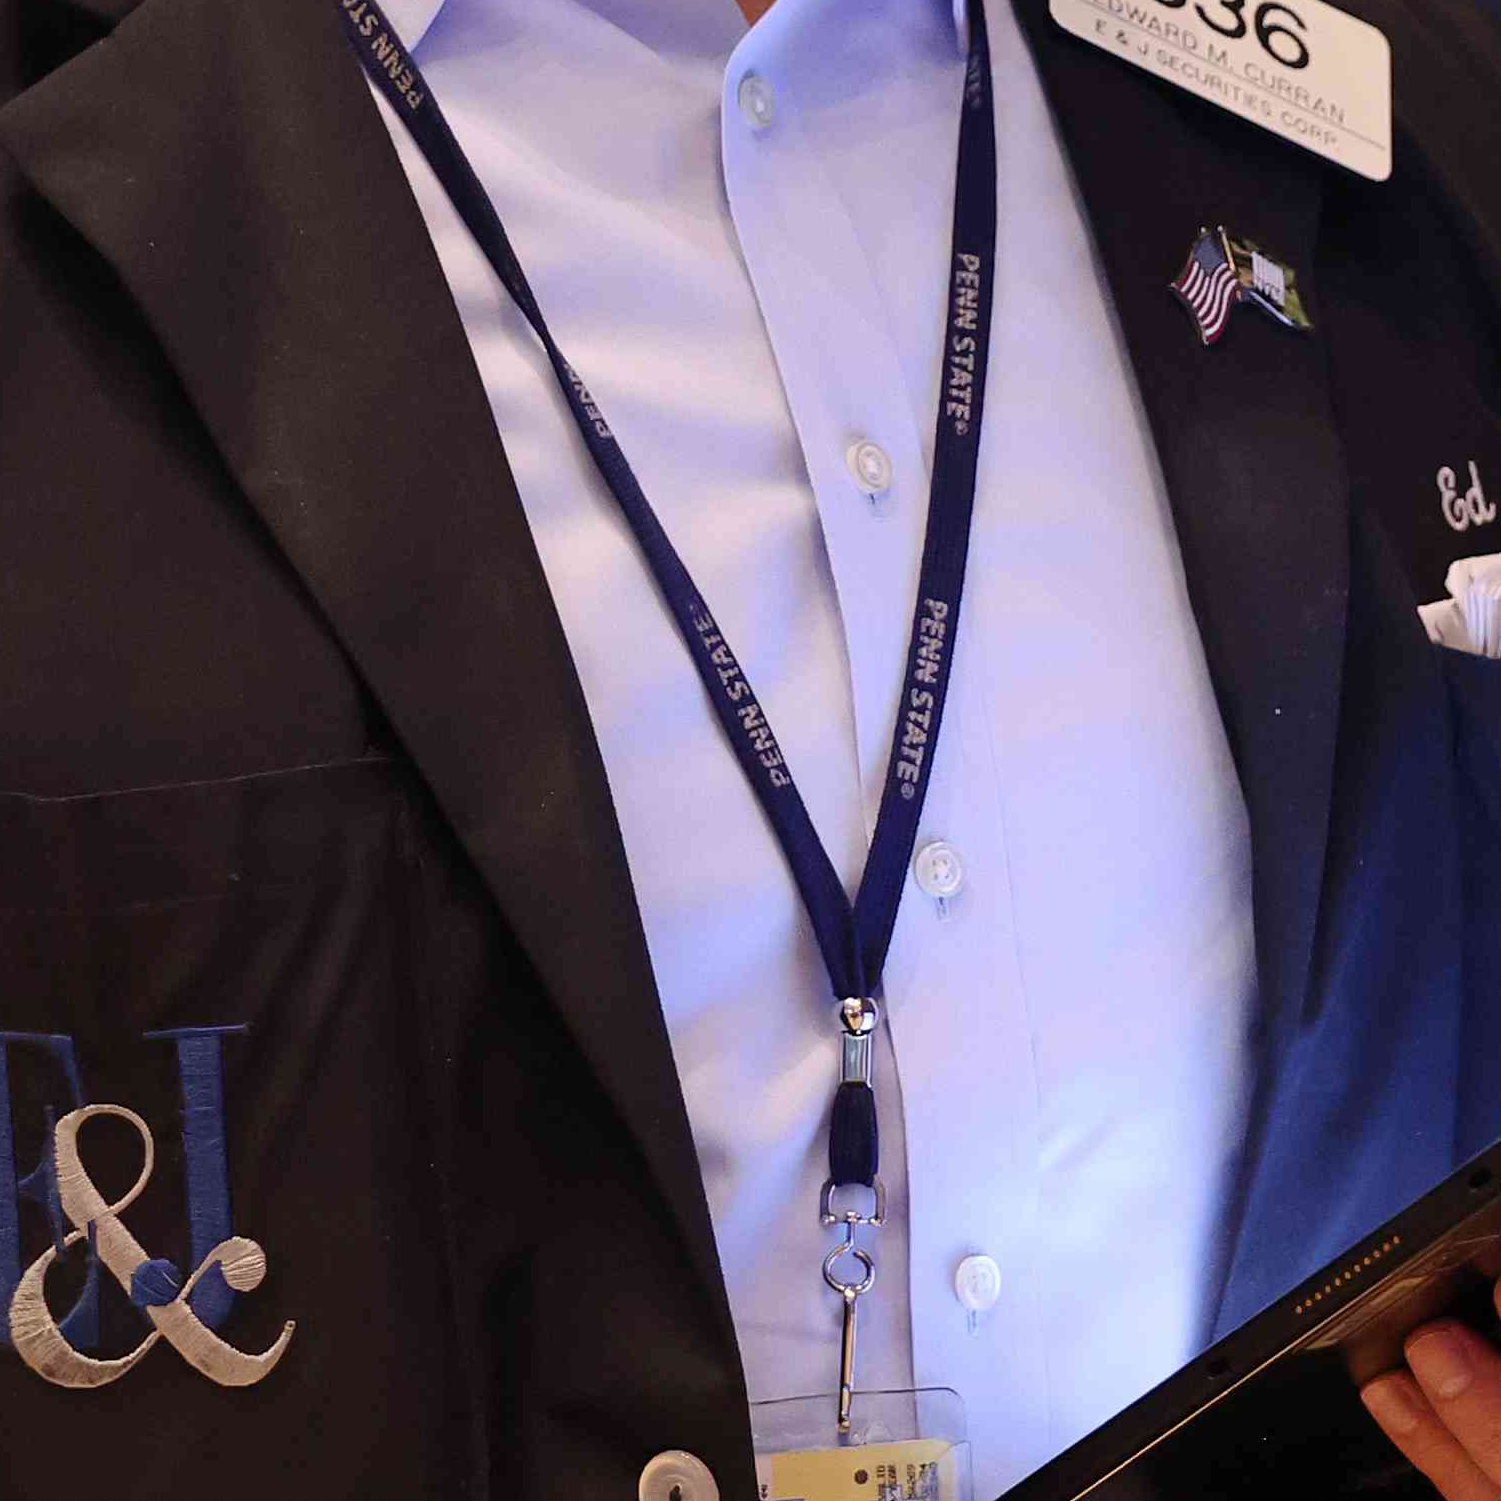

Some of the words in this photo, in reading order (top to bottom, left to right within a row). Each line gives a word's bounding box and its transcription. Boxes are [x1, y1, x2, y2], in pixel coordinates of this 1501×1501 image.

[371, 33, 425, 110] PENN
[1095, 18, 1108, 36] E
[1116, 29, 1129, 46] &
[1137, 42, 1149, 56] J
[1155, 49, 1274, 117] SECURITIES
[1244, 62, 1346, 124] CURRAN
[955, 252, 981, 331] PENN
[1436, 459, 1497, 532] Ed
[913, 597, 949, 684] PENN
[737, 702, 791, 788] PENN
